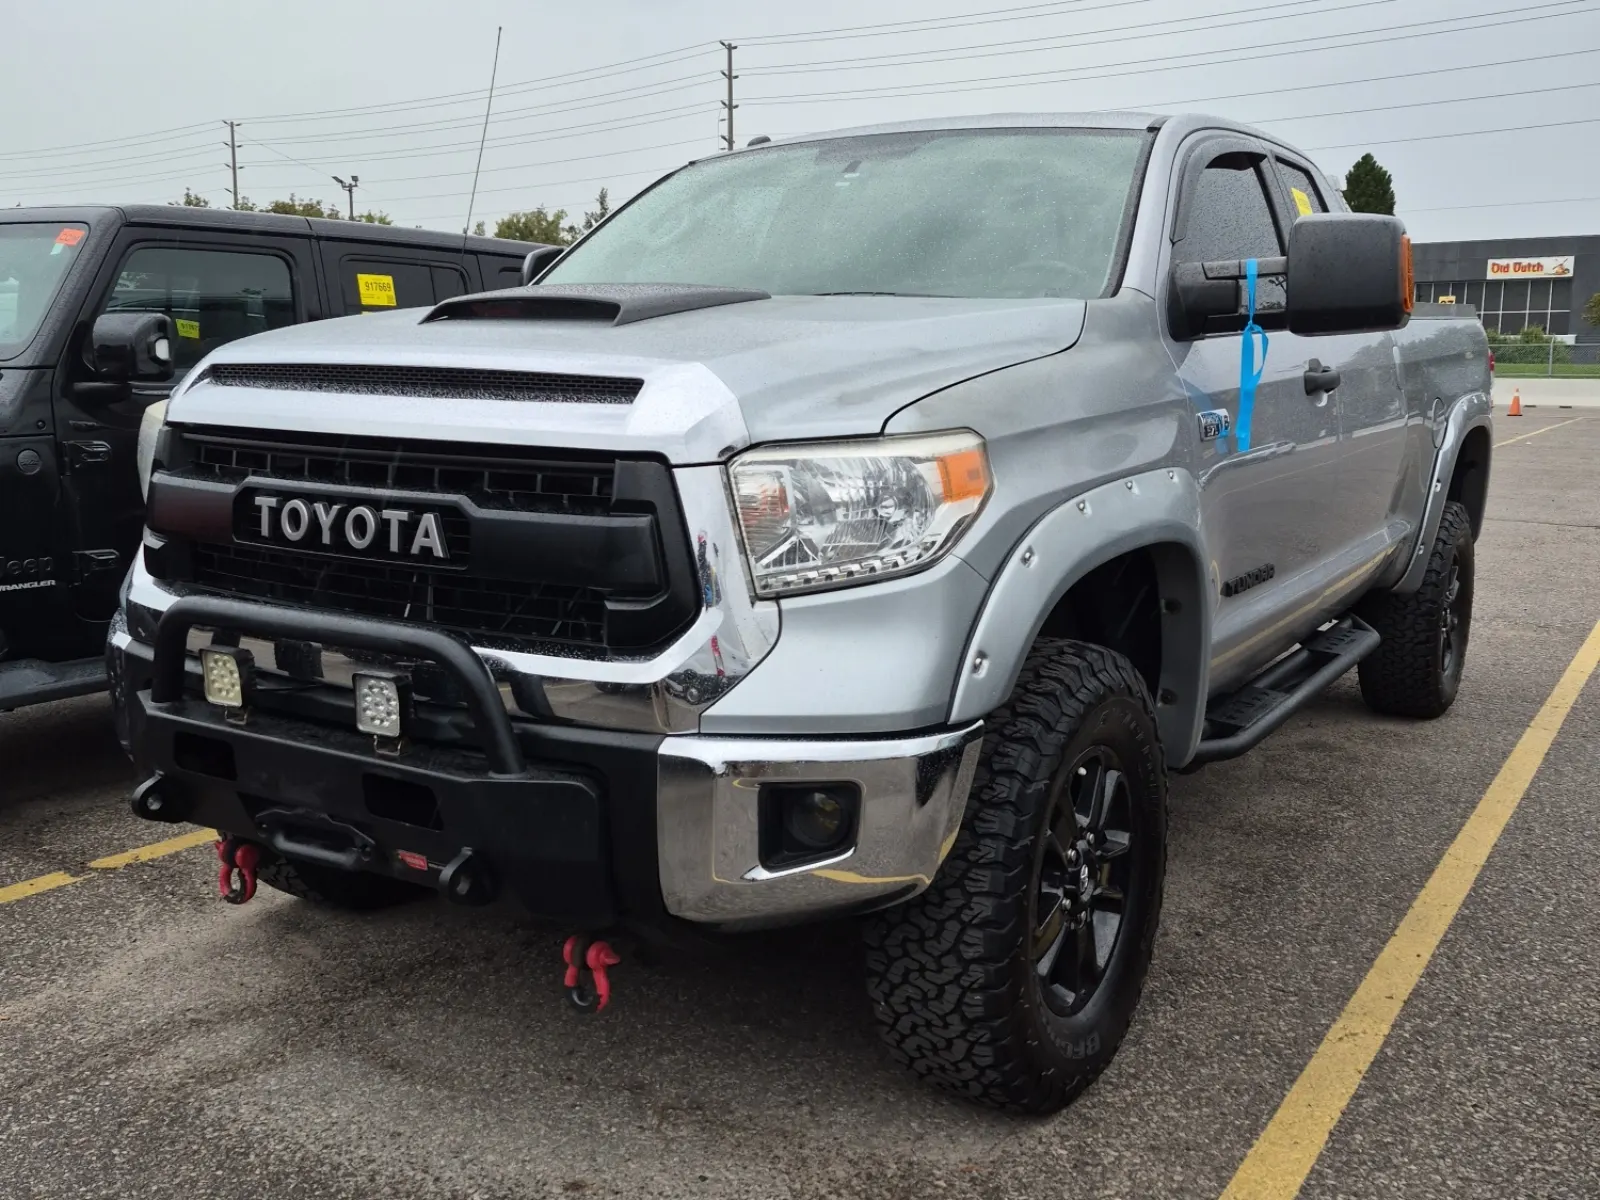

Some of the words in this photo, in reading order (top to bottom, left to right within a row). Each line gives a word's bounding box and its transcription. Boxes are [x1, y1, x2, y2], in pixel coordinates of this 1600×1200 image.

[1491, 262, 1510, 274] Old
[1513, 261, 1544, 273] Dutch
[254, 496, 449, 558] TOYOTA
[0, 579, 56, 592] RANGLER
[1219, 562, 1276, 597] TUNDRA
